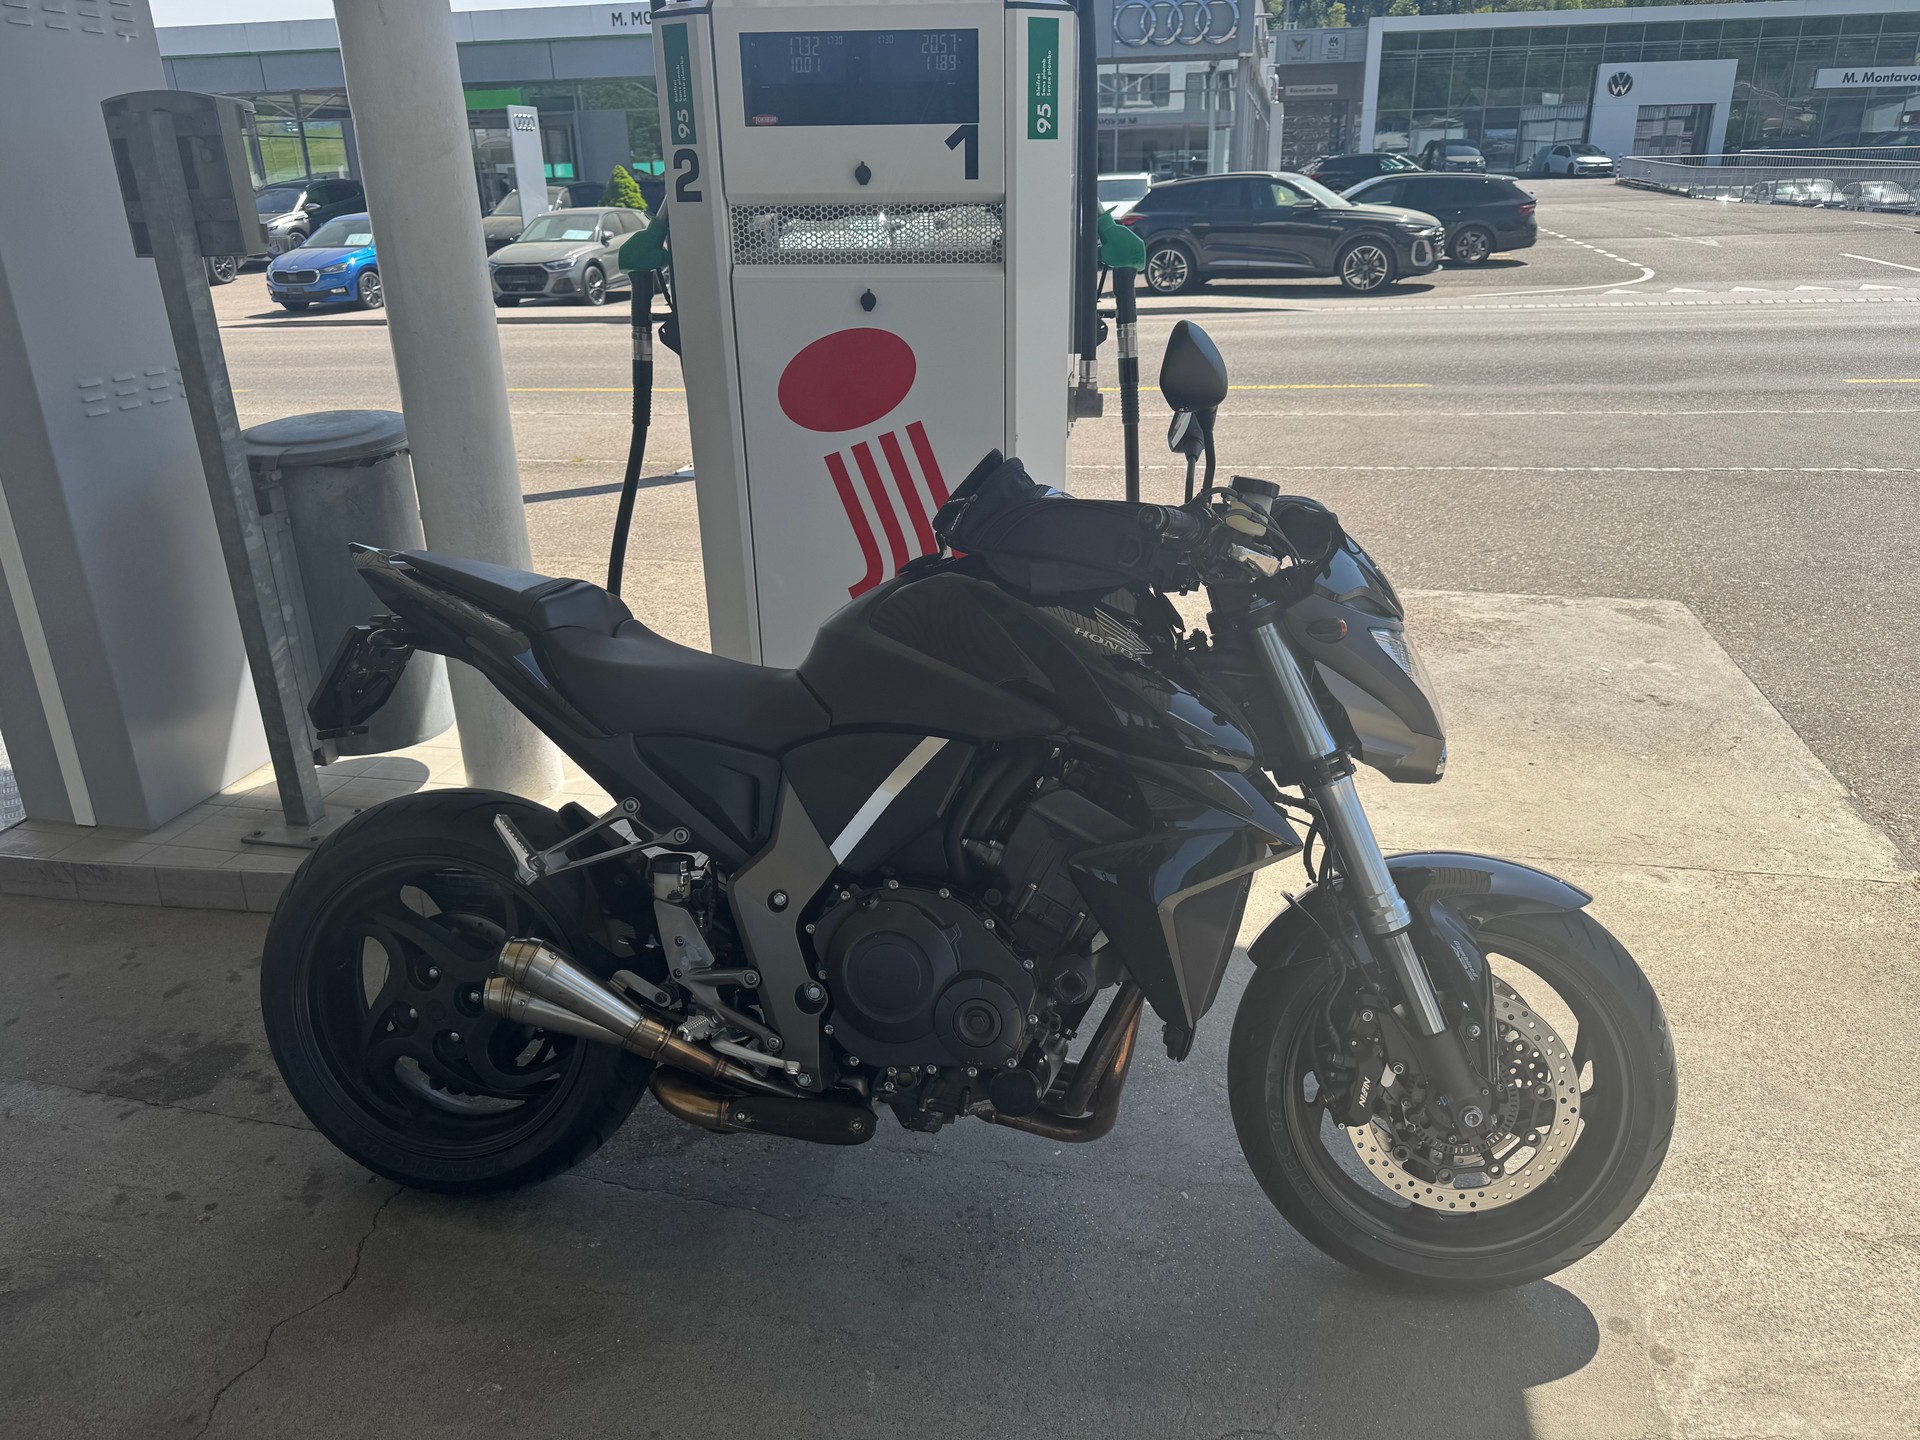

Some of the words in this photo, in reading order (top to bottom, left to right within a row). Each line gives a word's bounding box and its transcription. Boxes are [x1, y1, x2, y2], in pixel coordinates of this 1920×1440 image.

[611, 12, 627, 27] M.
[1842, 72, 1858, 83] M.
[677, 108, 691, 138] 95
[1037, 104, 1052, 134] 95
[944, 125, 979, 180] 1
[673, 148, 703, 202] 2
[1074, 627, 1153, 669] HONDA
